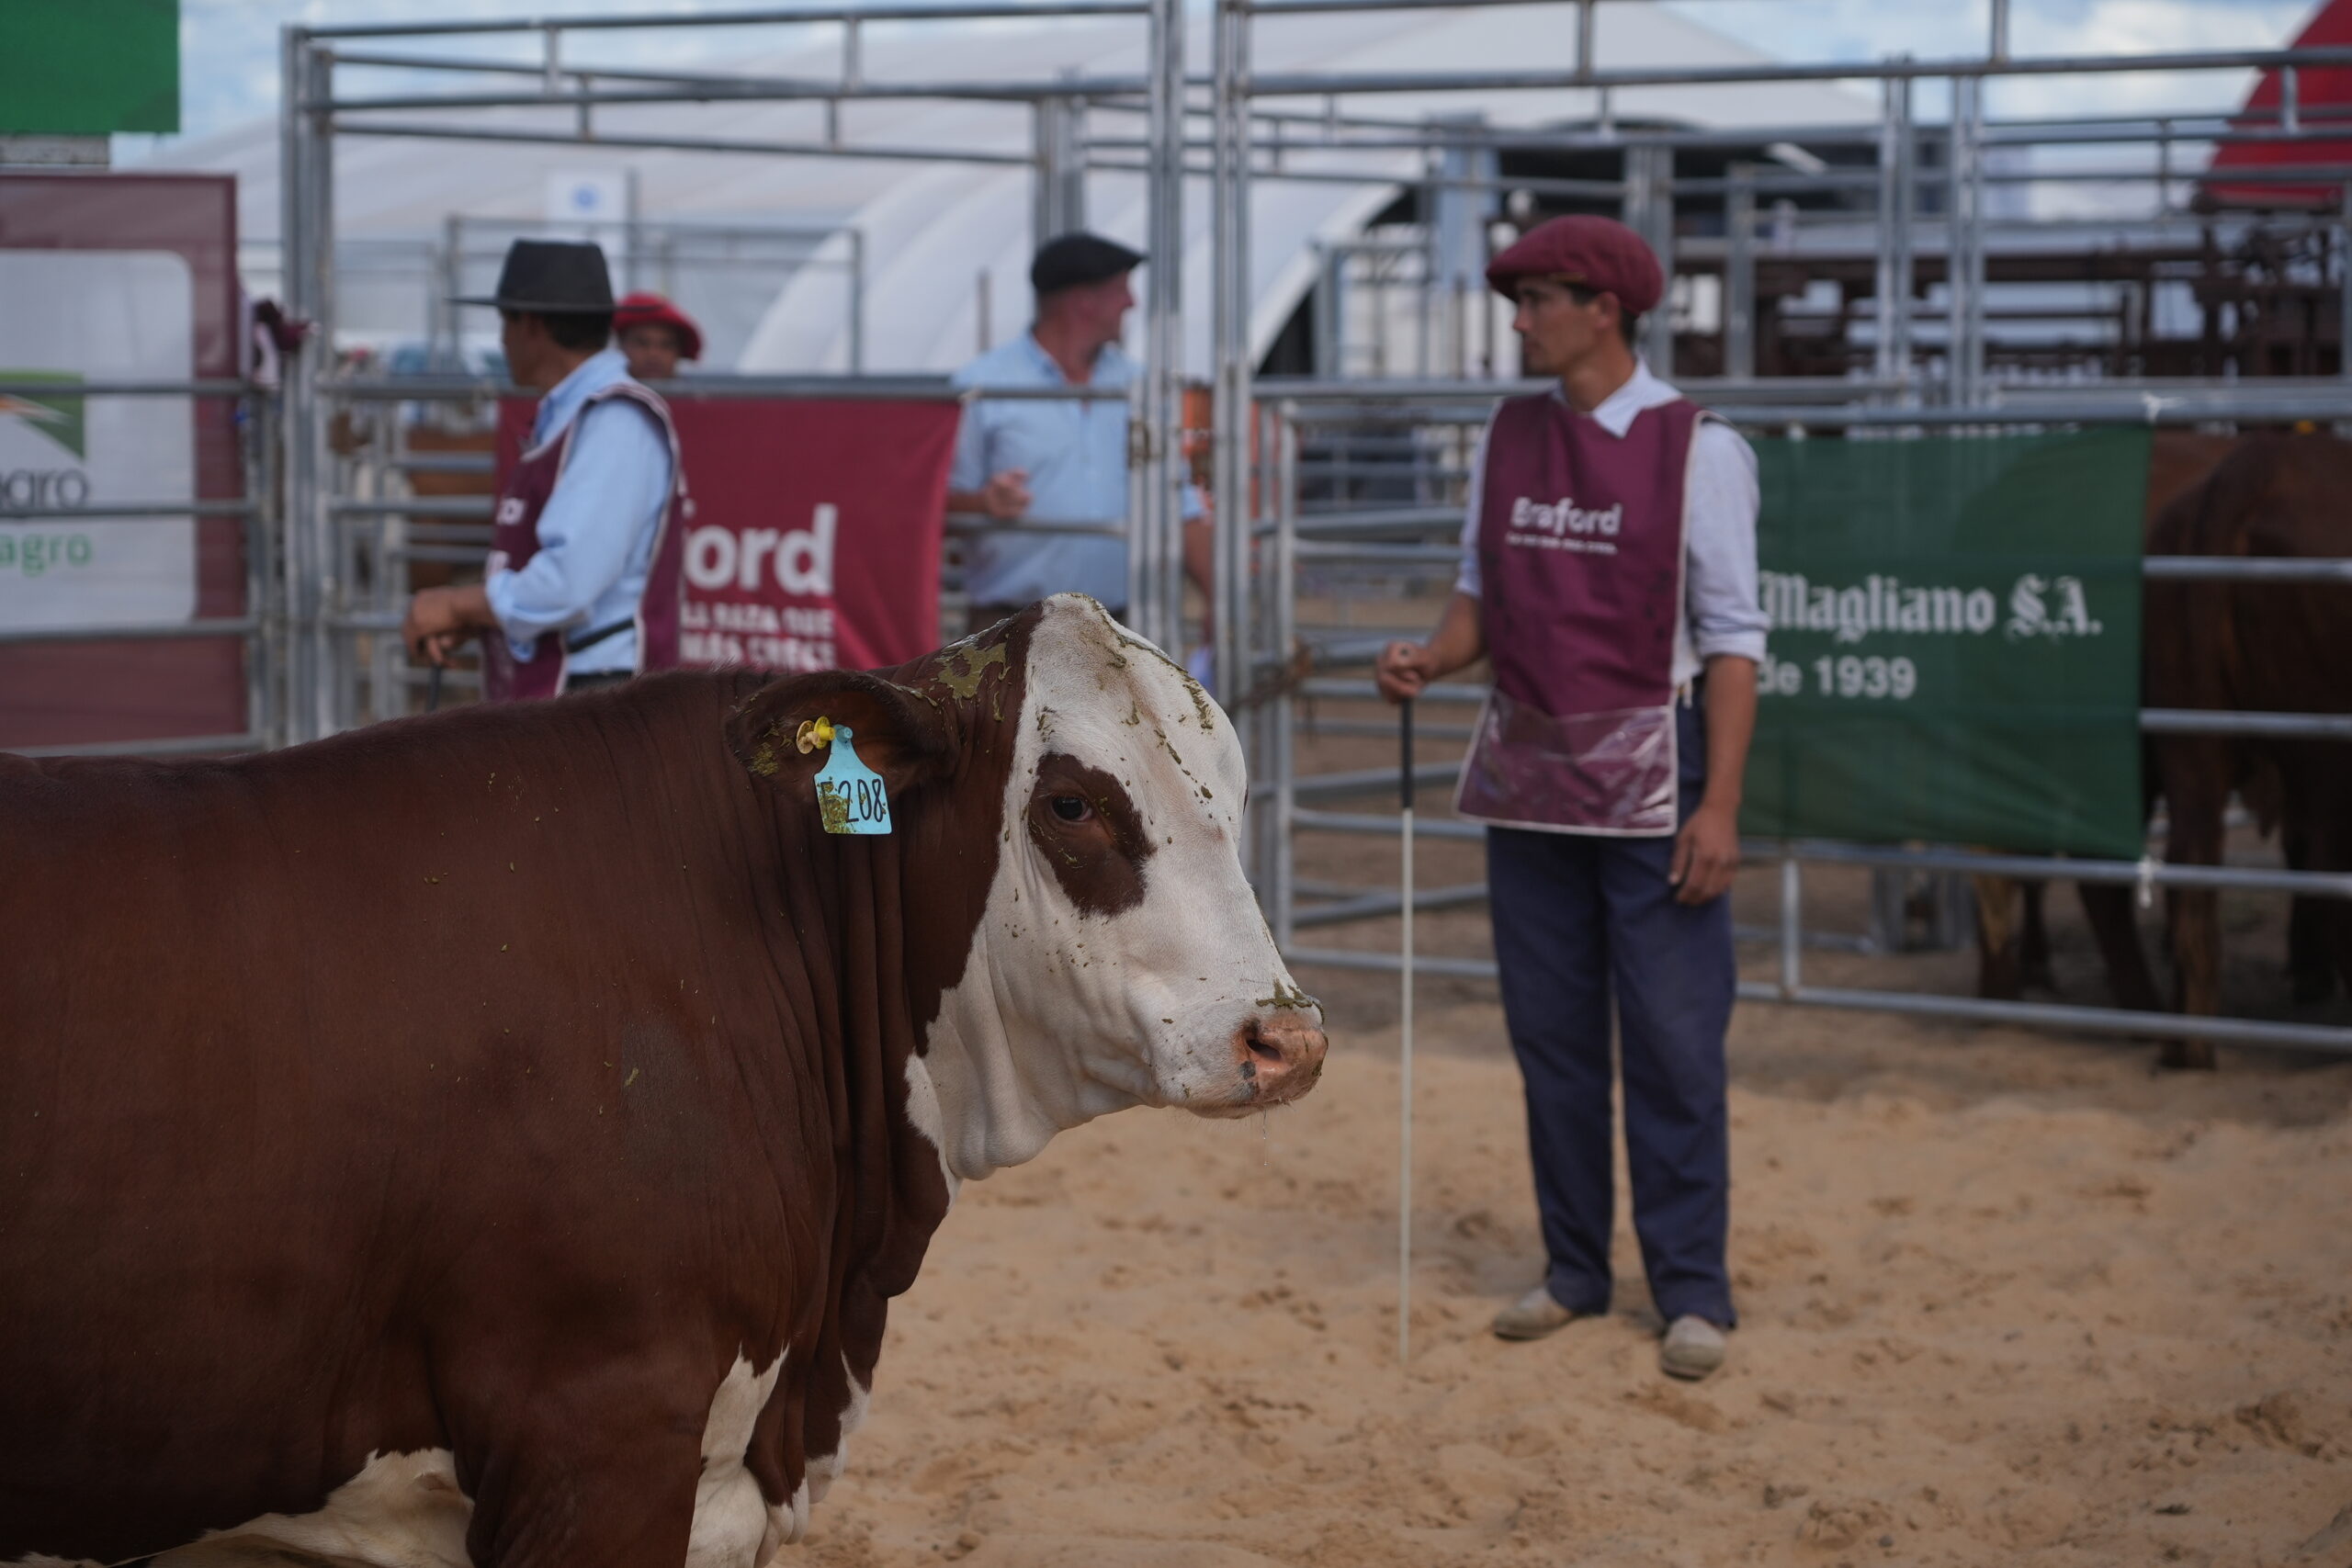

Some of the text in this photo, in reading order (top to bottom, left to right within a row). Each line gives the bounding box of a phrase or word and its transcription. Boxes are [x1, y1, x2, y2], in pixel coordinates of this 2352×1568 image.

[684, 500, 836, 595] ord
[1759, 570, 1995, 644] Magliano
[1815, 655, 1917, 699] 1939
